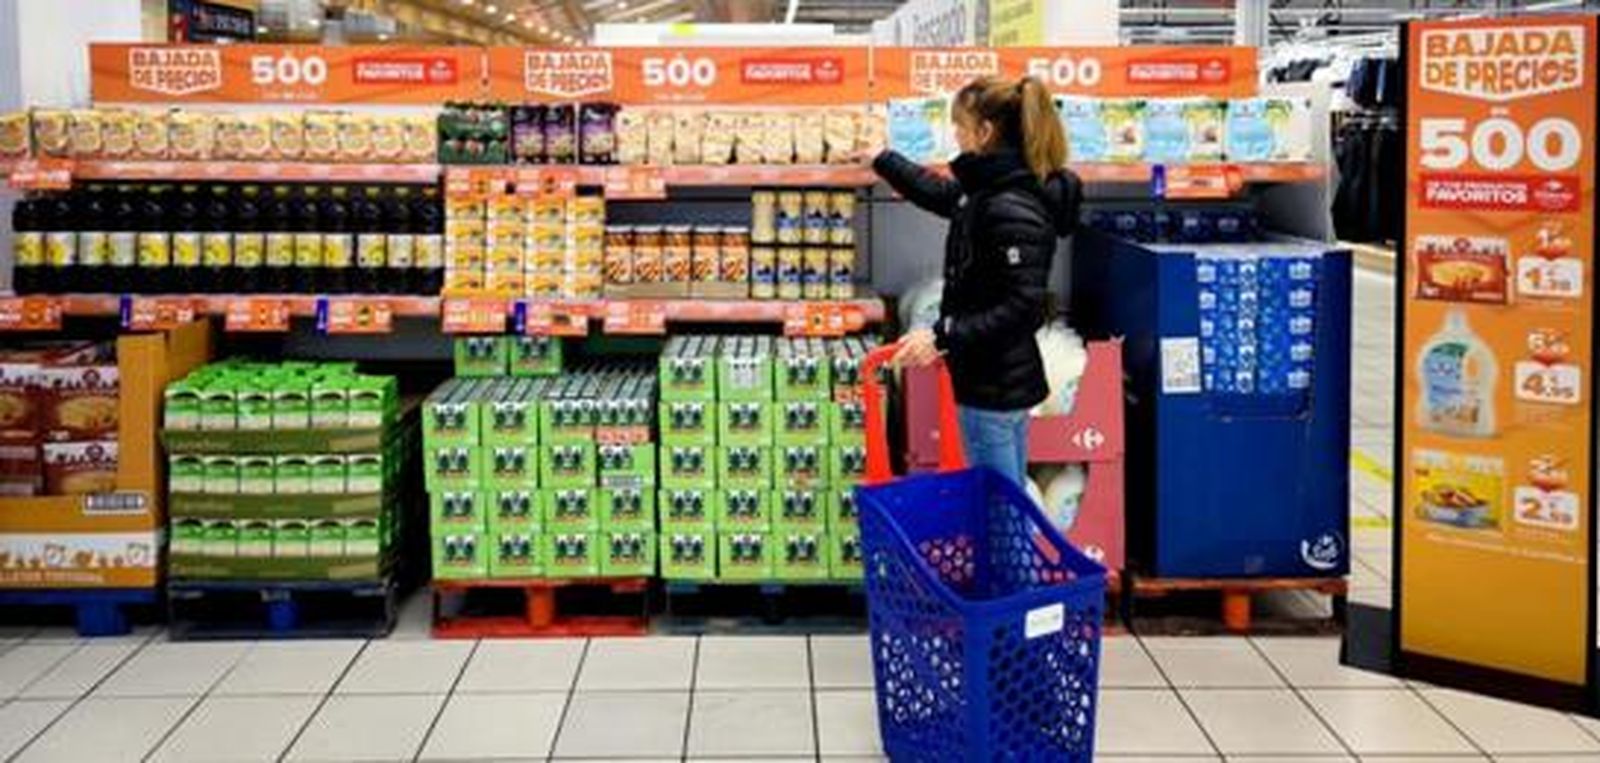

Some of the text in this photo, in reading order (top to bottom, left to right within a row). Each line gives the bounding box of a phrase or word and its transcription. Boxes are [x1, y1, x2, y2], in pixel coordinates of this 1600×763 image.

[1426, 30, 1574, 57] BAJADA
[133, 52, 215, 66] BAJADA
[251, 57, 327, 84] 500
[528, 54, 608, 69] BAJADA
[642, 57, 717, 85] 500
[915, 54, 994, 70] BAJADA
[1027, 57, 1102, 86] 500
[134, 69, 217, 90] DE PRECIOS
[1426, 59, 1577, 92] DE PRECIOS
[1420, 117, 1582, 171] 500
